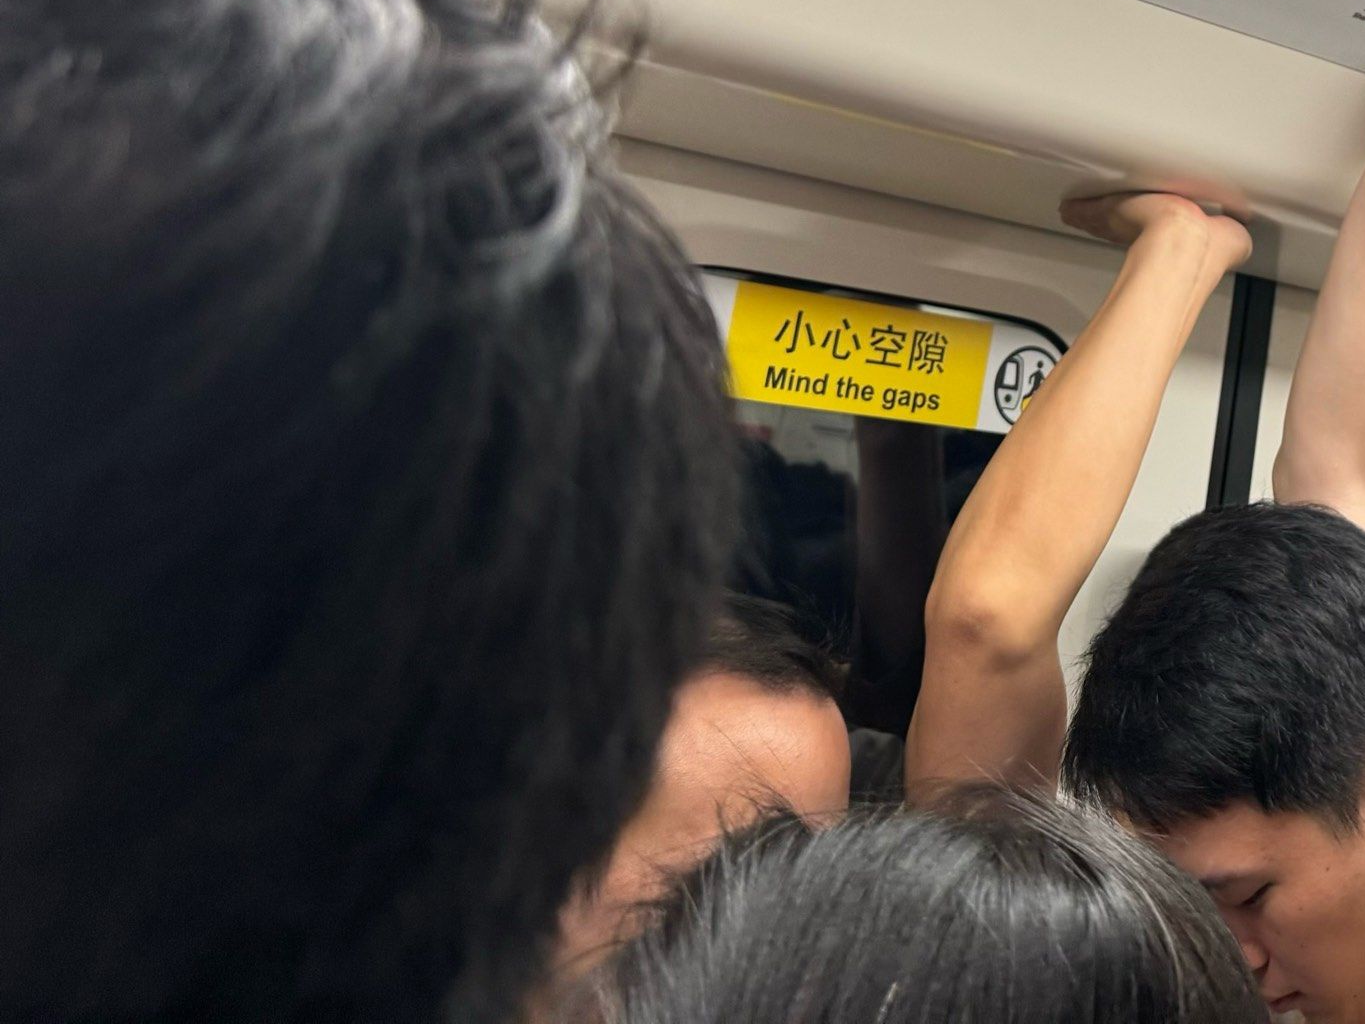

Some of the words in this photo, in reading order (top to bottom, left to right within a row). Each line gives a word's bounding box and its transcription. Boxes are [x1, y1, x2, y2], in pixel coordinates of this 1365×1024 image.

[773, 309, 949, 376] 小心空隙
[764, 365, 829, 396] Mind
[836, 375, 875, 402] the
[881, 386, 940, 413] gaps
